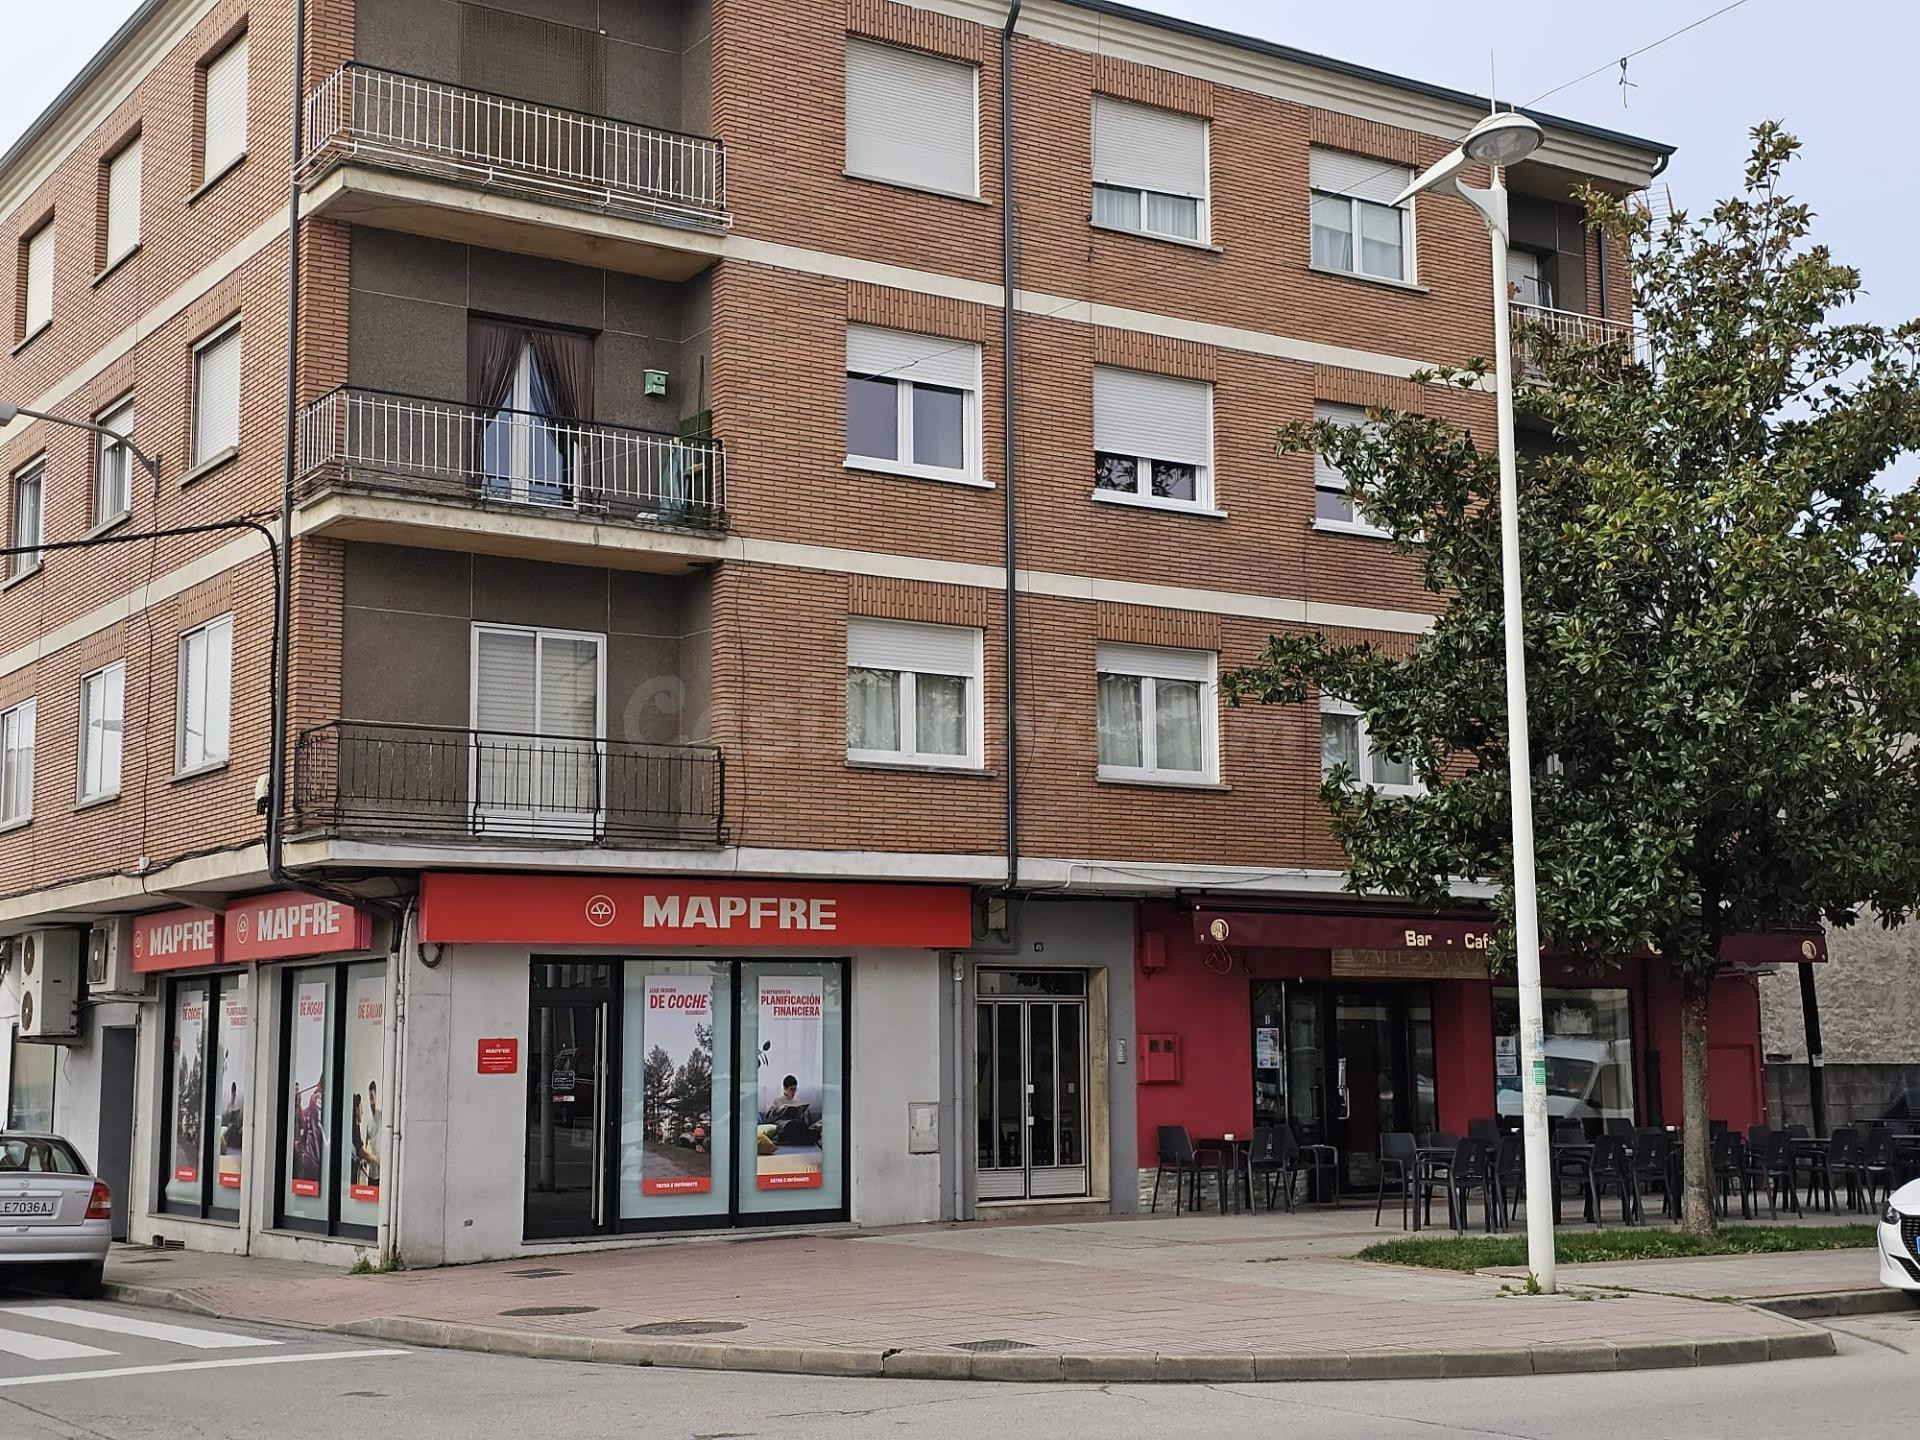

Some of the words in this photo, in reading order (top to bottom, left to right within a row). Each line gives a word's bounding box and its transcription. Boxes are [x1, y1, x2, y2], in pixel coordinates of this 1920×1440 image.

[642, 895, 837, 930] MAPFRE
[257, 901, 340, 942] MAPFRE
[149, 918, 214, 957] MAPFRE
[1405, 930, 1433, 947] Bar
[650, 994, 665, 1009] DE
[668, 994, 708, 1009] COCHE
[761, 992, 821, 1005] PLANIFICACIÓN
[358, 1004, 365, 1019] DE
[366, 1003, 383, 1019] SALUD
[773, 1006, 820, 1016] FINANCIERA
